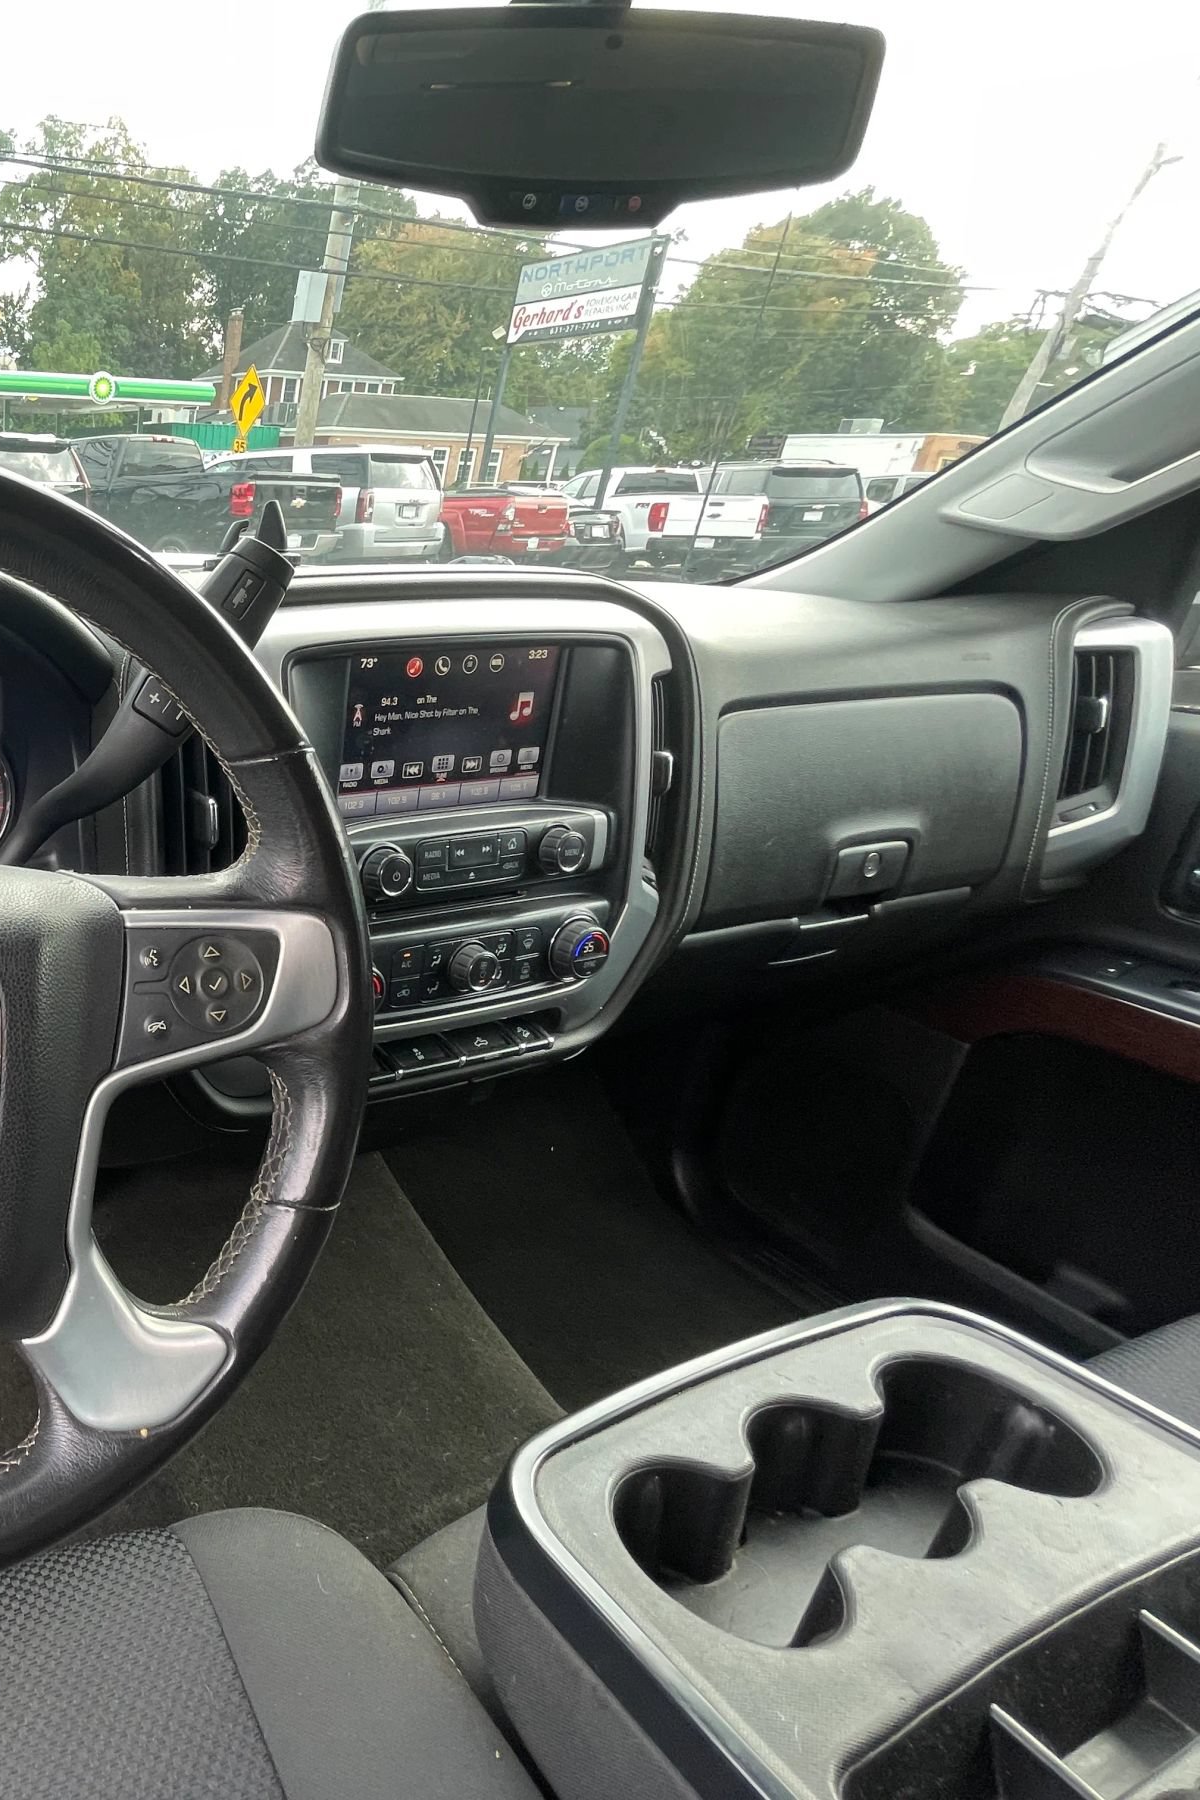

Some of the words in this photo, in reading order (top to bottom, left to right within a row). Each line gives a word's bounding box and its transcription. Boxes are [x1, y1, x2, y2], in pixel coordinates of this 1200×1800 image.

[521, 244, 650, 283] NORTHPORT
[554, 277, 618, 293] Motors
[513, 300, 584, 335] Gerhard's
[235, 440, 245, 453] 35
[381, 697, 399, 707] 94.3
[374, 712, 388, 723] Hey
[404, 710, 419, 720] Nice
[424, 850, 441, 858] RADIO
[422, 872, 441, 881] MEDIA
